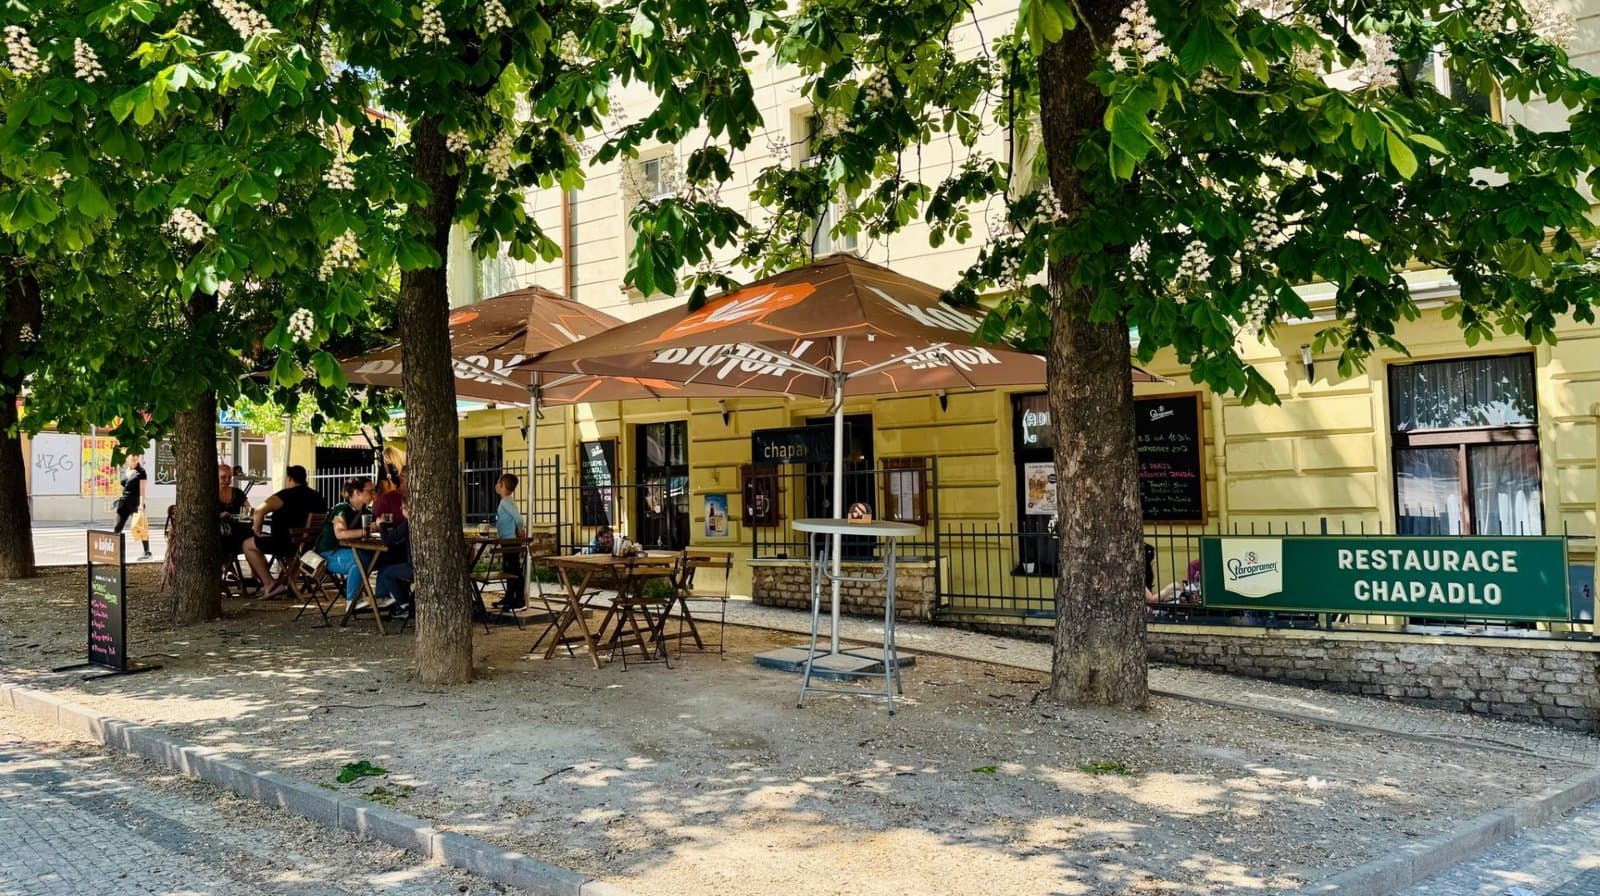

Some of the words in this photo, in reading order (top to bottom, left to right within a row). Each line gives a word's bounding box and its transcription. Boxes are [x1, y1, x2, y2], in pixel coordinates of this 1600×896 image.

[1227, 558, 1279, 581] Staropramen
[1337, 548, 1519, 573] RESTAURACE
[1353, 579, 1503, 606] CHAPADLO
